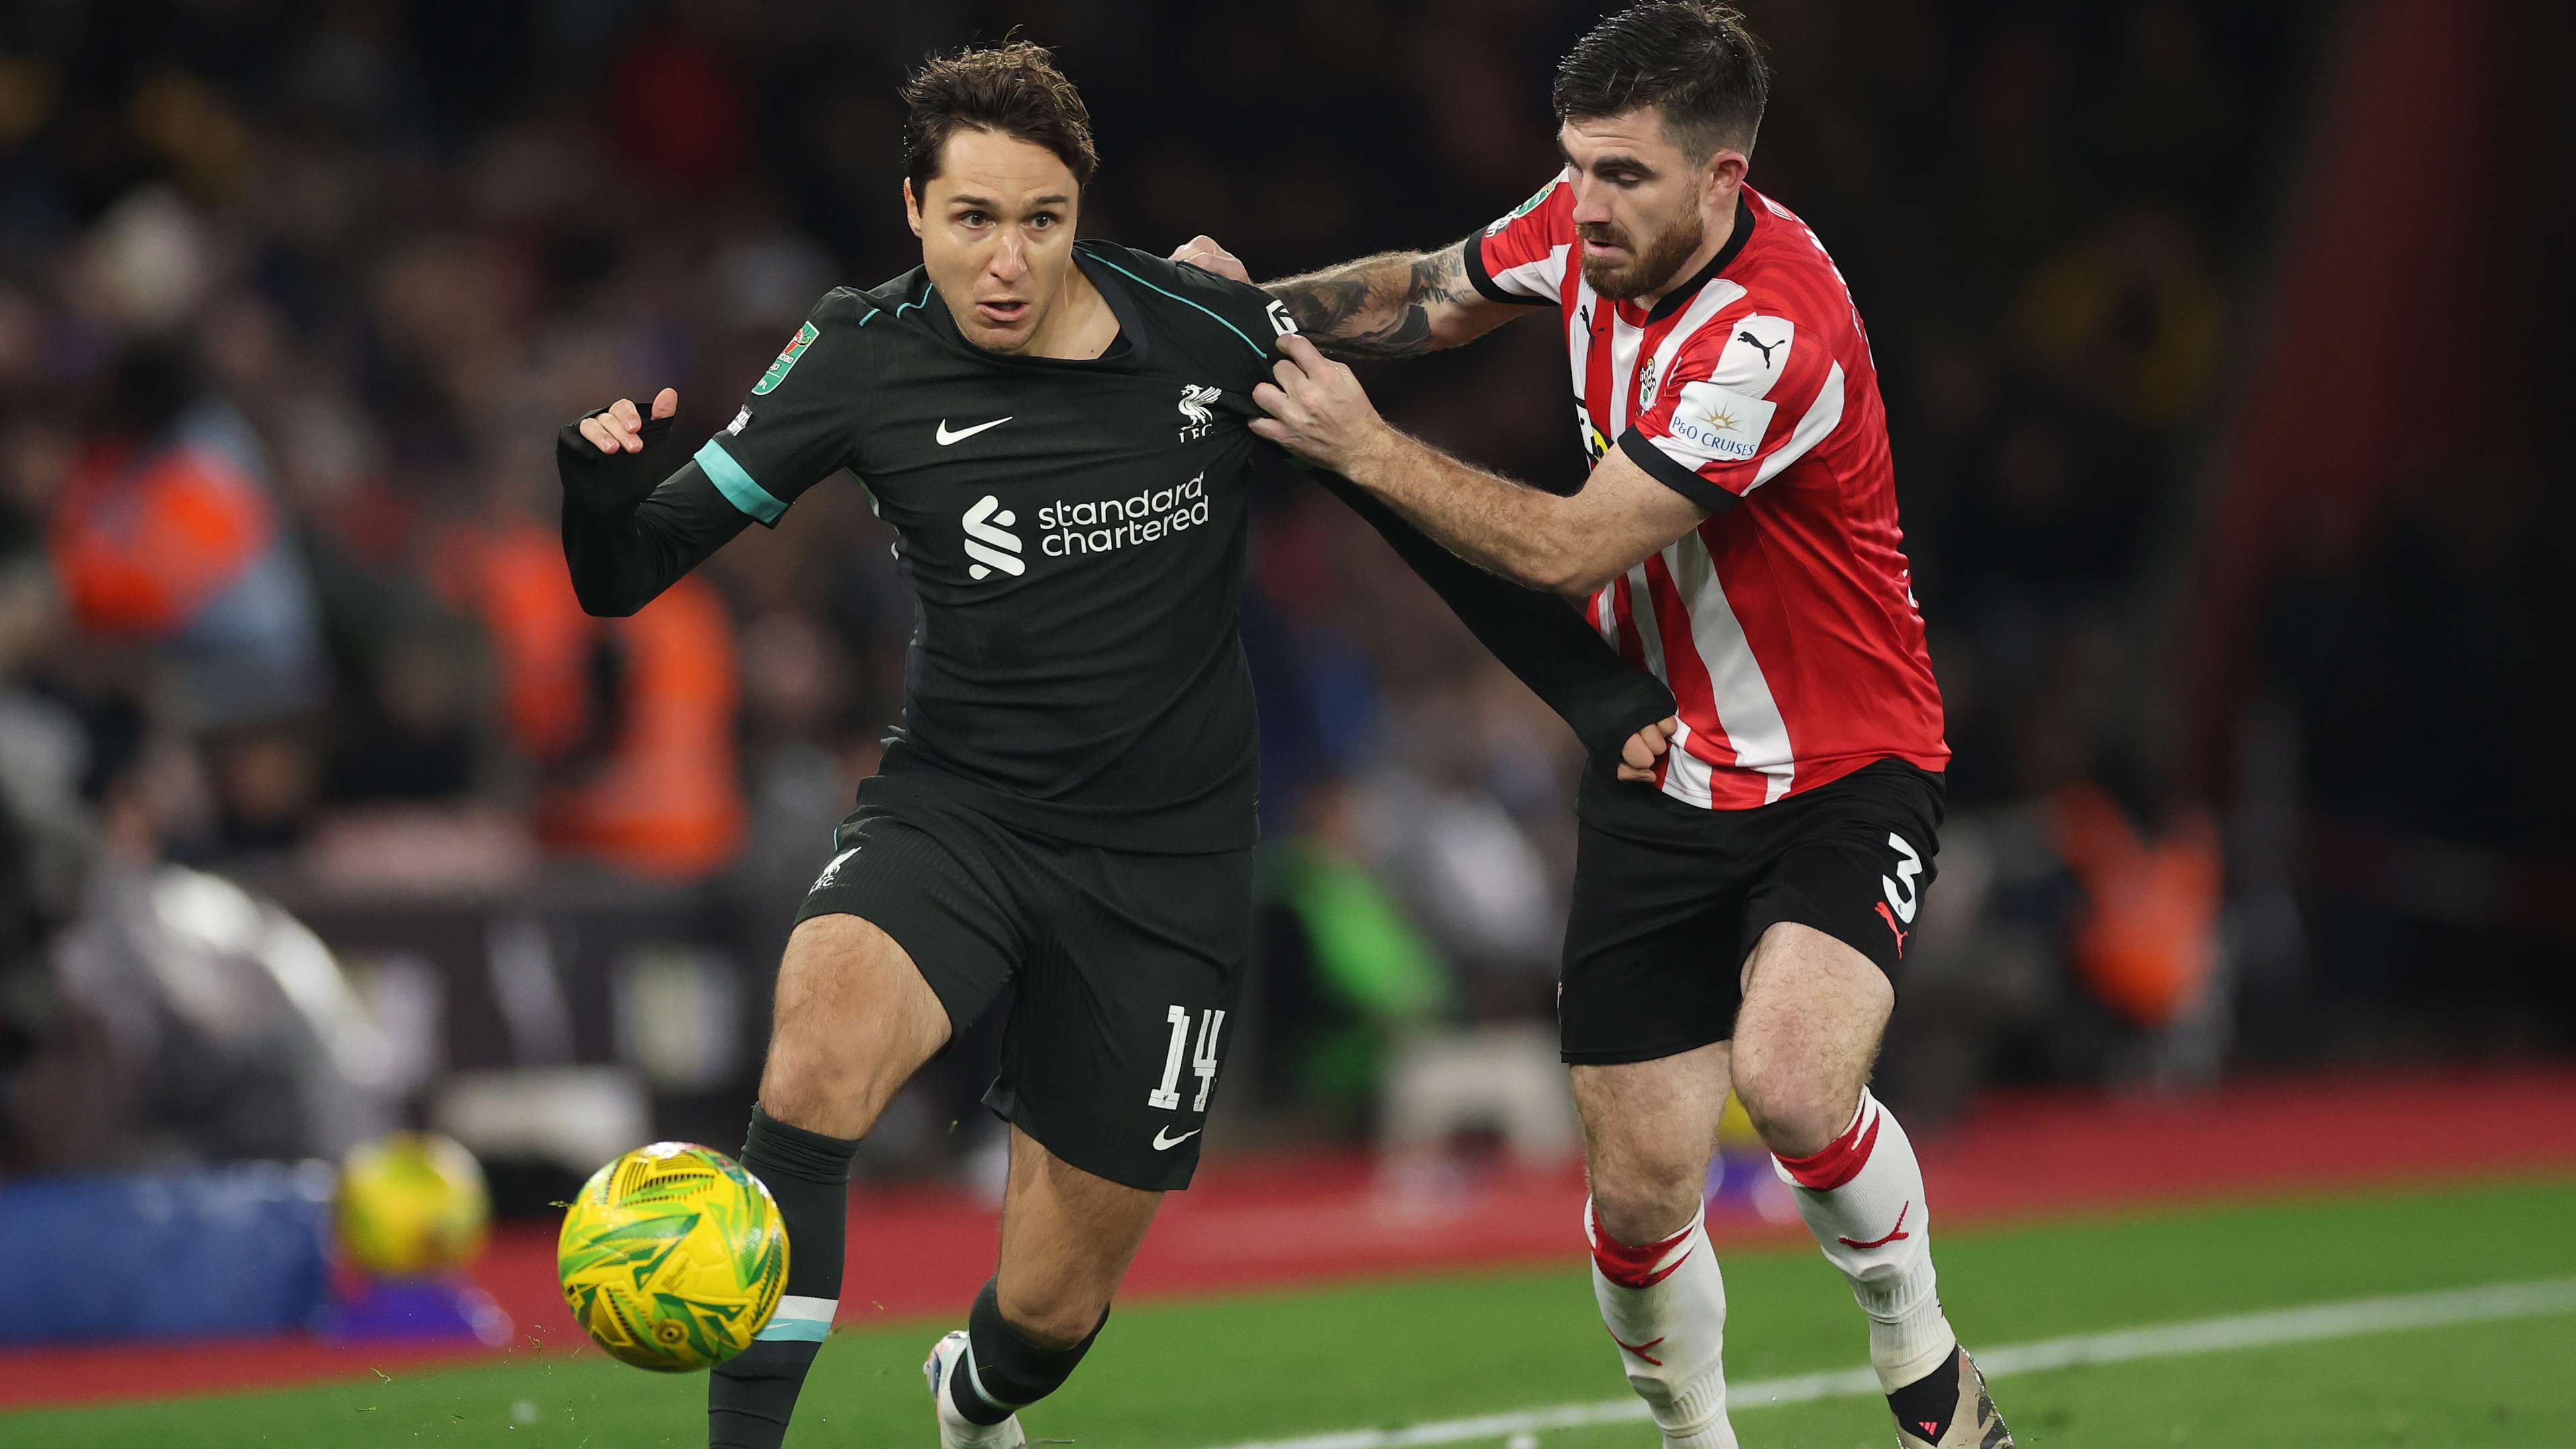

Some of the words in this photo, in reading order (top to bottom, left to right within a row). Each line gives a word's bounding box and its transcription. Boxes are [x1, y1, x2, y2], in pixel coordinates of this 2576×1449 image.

[1672, 416, 1698, 439] P&O
[1701, 432, 1756, 457] CRUISES
[1038, 470, 1205, 530] standard
[1041, 494, 1210, 557] chartered
[1882, 832, 1923, 924] 3
[1148, 1005, 1226, 1112] 14
